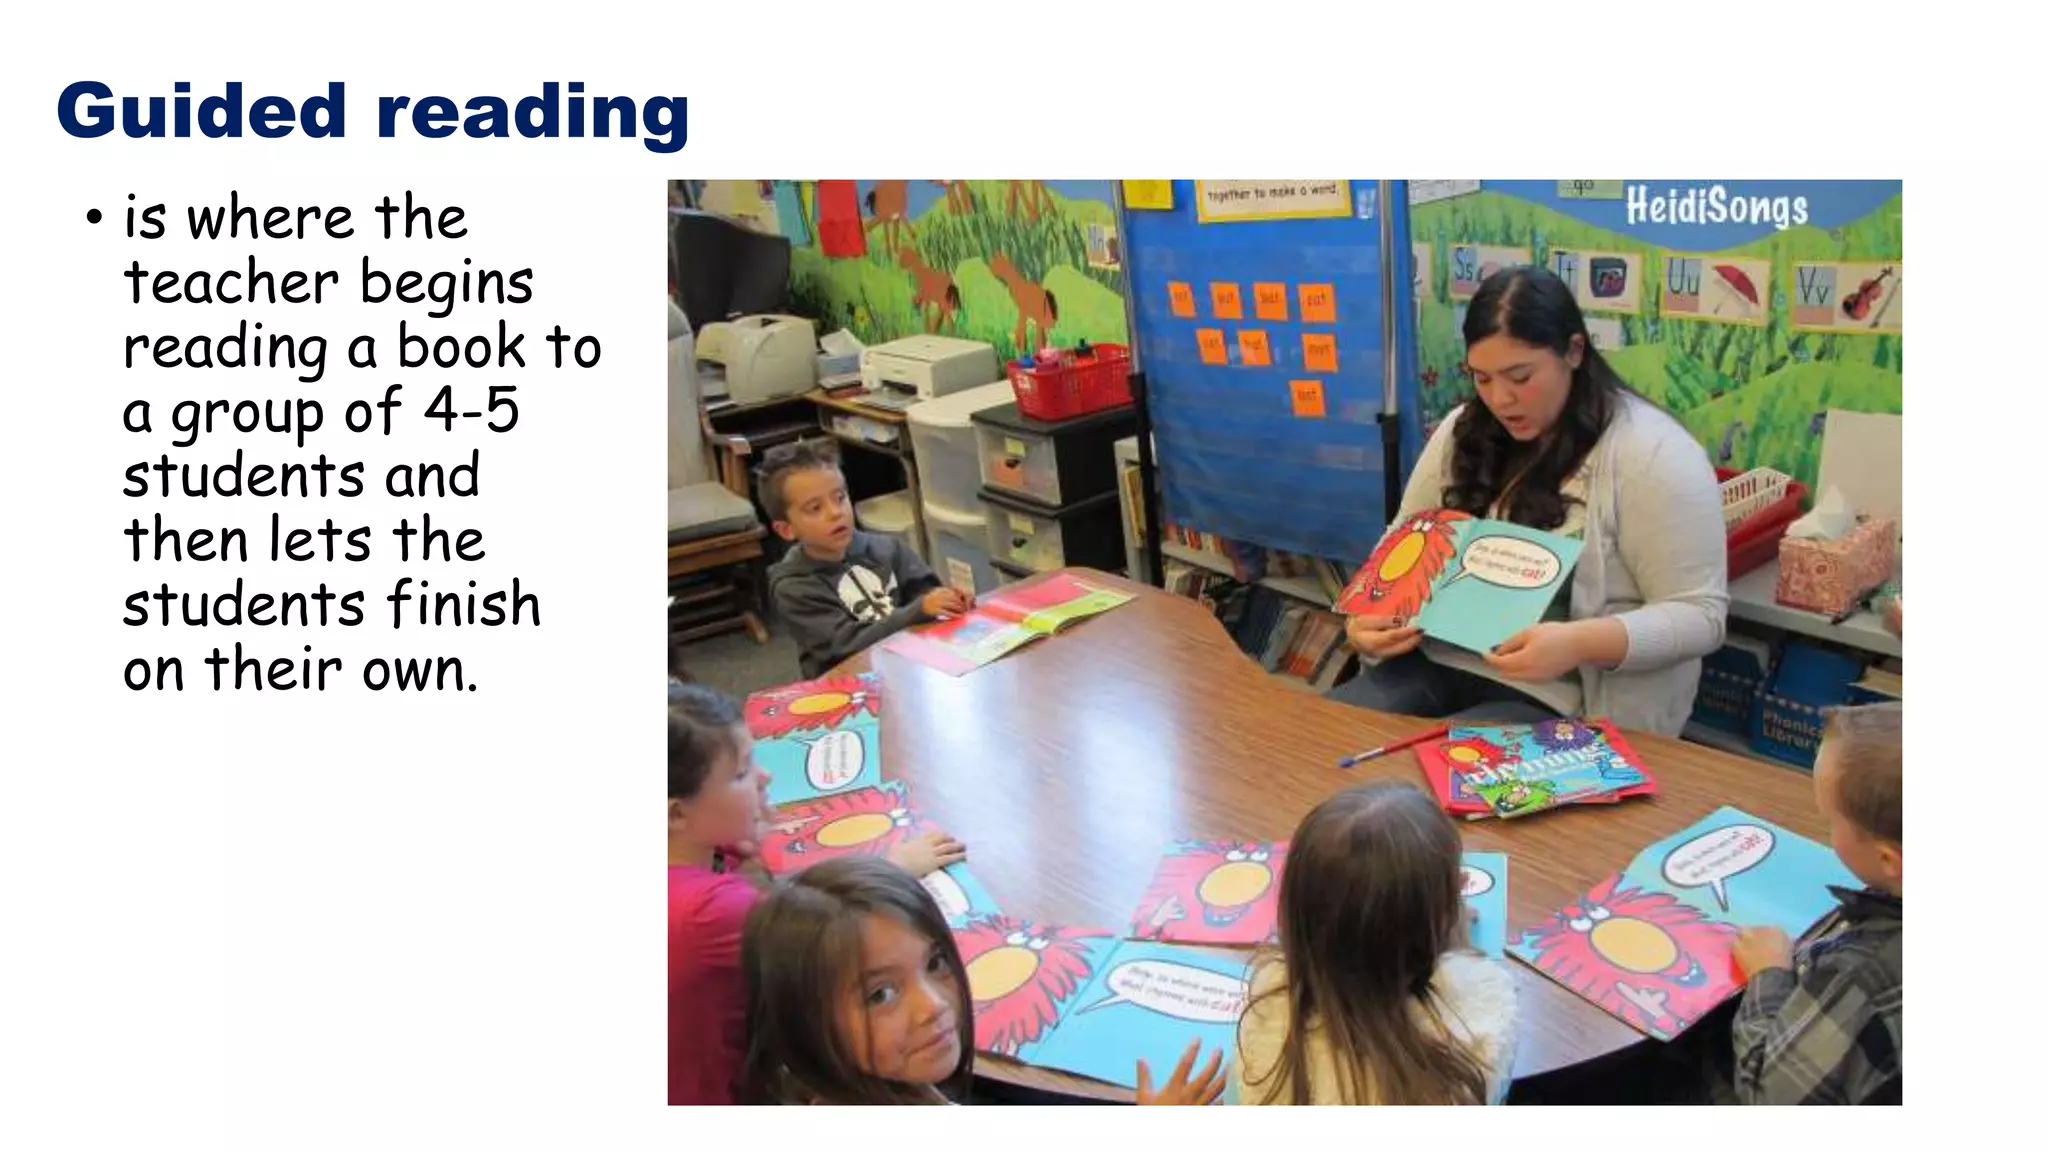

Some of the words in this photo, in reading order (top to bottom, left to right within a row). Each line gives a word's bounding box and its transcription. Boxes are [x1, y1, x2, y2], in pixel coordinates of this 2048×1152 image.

[1254, 187, 1266, 199] to
[1669, 257, 1699, 295] Uu
[1799, 266, 1829, 304] Vv
